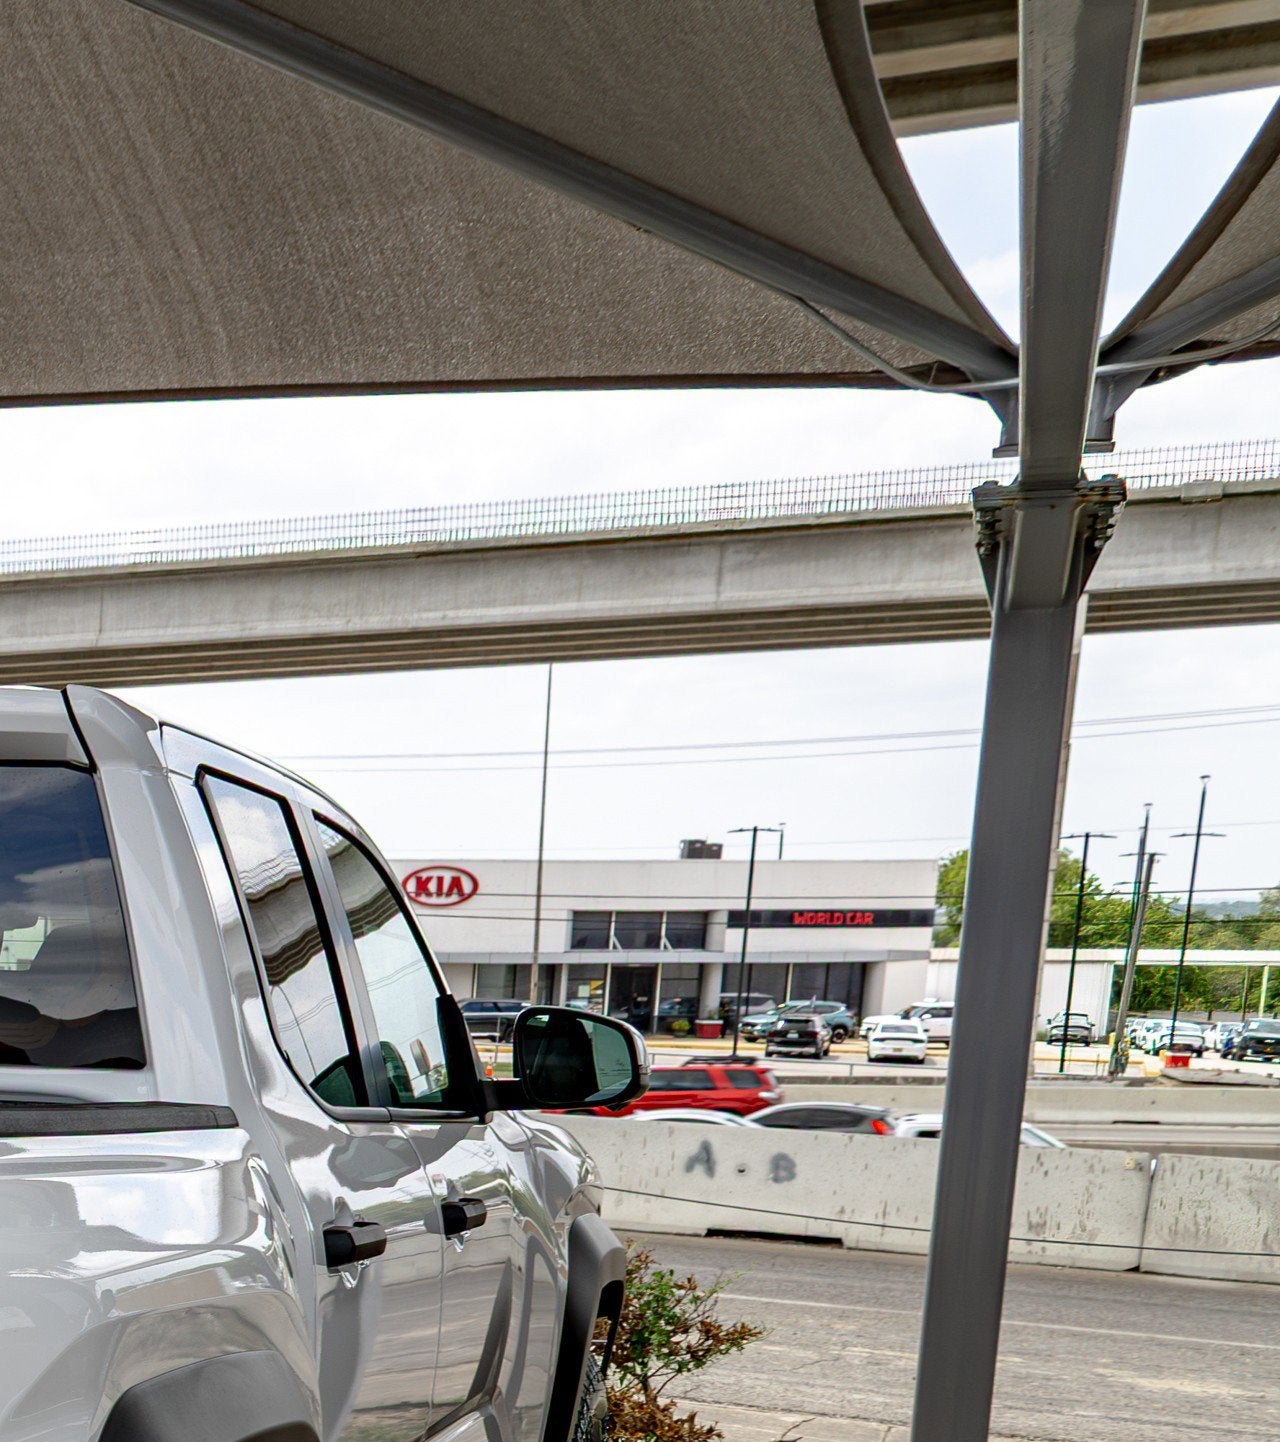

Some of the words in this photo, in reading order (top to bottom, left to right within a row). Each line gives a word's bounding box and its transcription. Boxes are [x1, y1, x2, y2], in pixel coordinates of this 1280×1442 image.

[415, 876, 465, 897] KIA
[792, 911, 843, 925] WORLD
[846, 911, 874, 925] CAR
